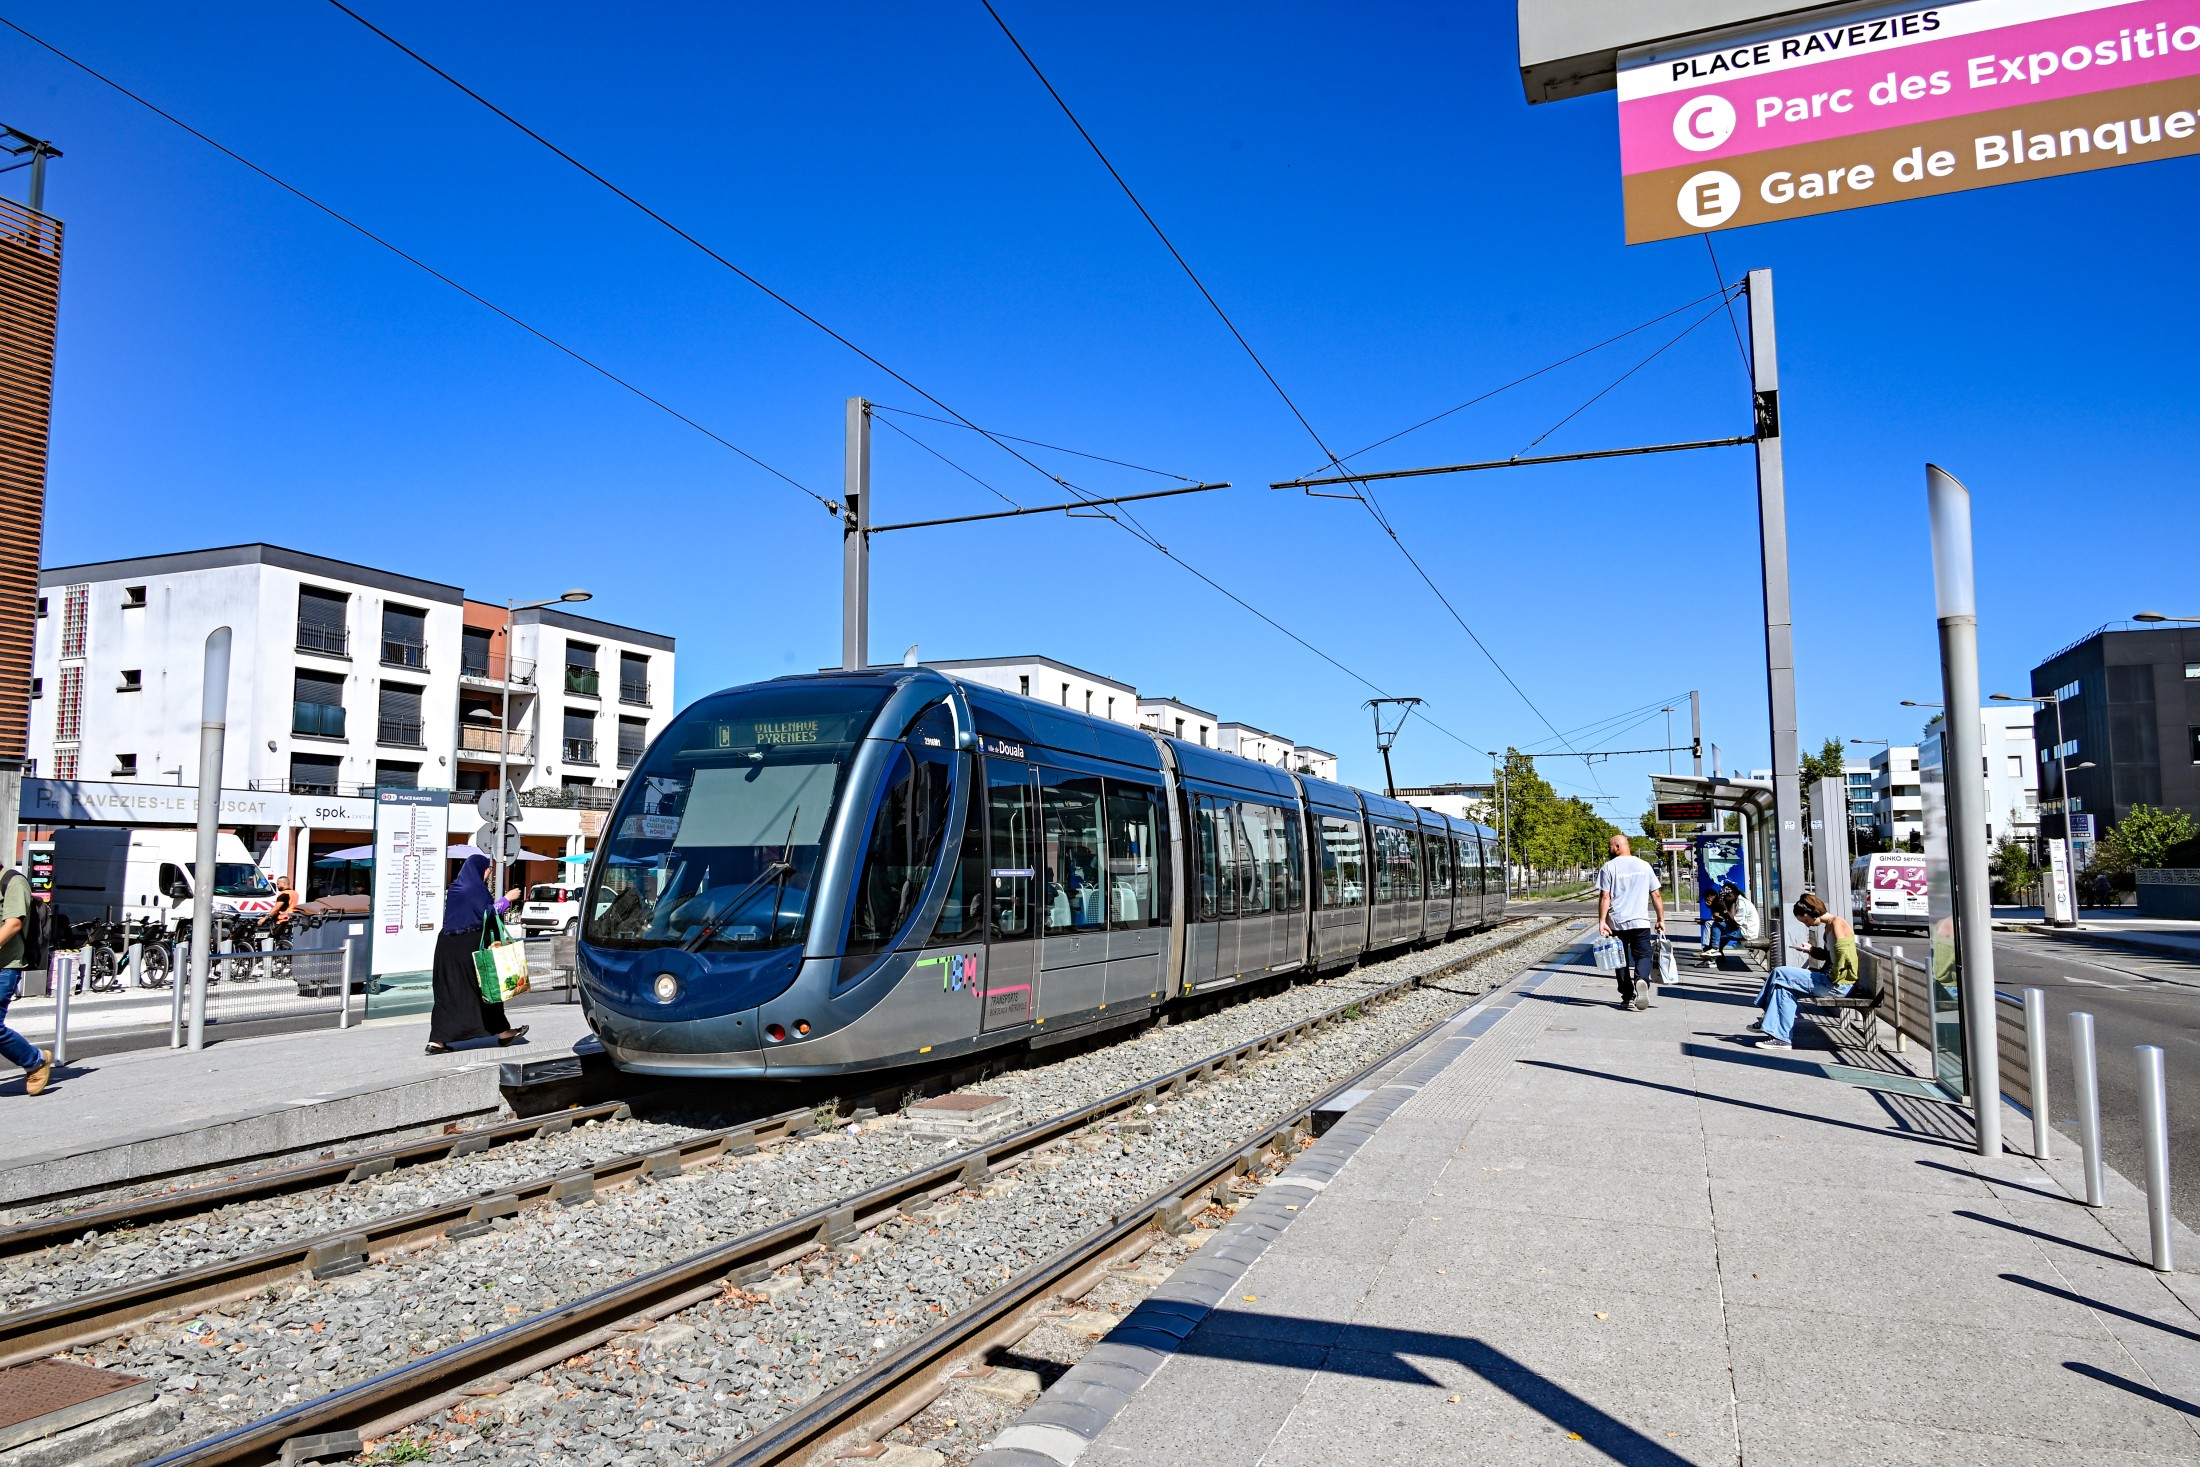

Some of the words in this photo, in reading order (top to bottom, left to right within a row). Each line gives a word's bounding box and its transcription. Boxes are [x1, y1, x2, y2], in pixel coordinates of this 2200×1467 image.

[1671, 45, 1771, 82] PLACE
[1781, 11, 1941, 61] RAVEZIES
[1686, 106, 1714, 139] C
[1756, 85, 1853, 128] Parc
[1867, 64, 1952, 106] des
[1967, 21, 2200, 91] Expositio
[1694, 179, 1722, 216] E
[1759, 159, 1874, 206] Gare
[1891, 146, 1956, 183] de
[1974, 109, 2200, 171] Blanque
[754, 720, 819, 733] VILLENAVE
[757, 732, 816, 744] PYRENEES
[999, 740, 1024, 758] Douala
[193, 799, 266, 814] BUSCAT
[315, 806, 350, 820] spok.
